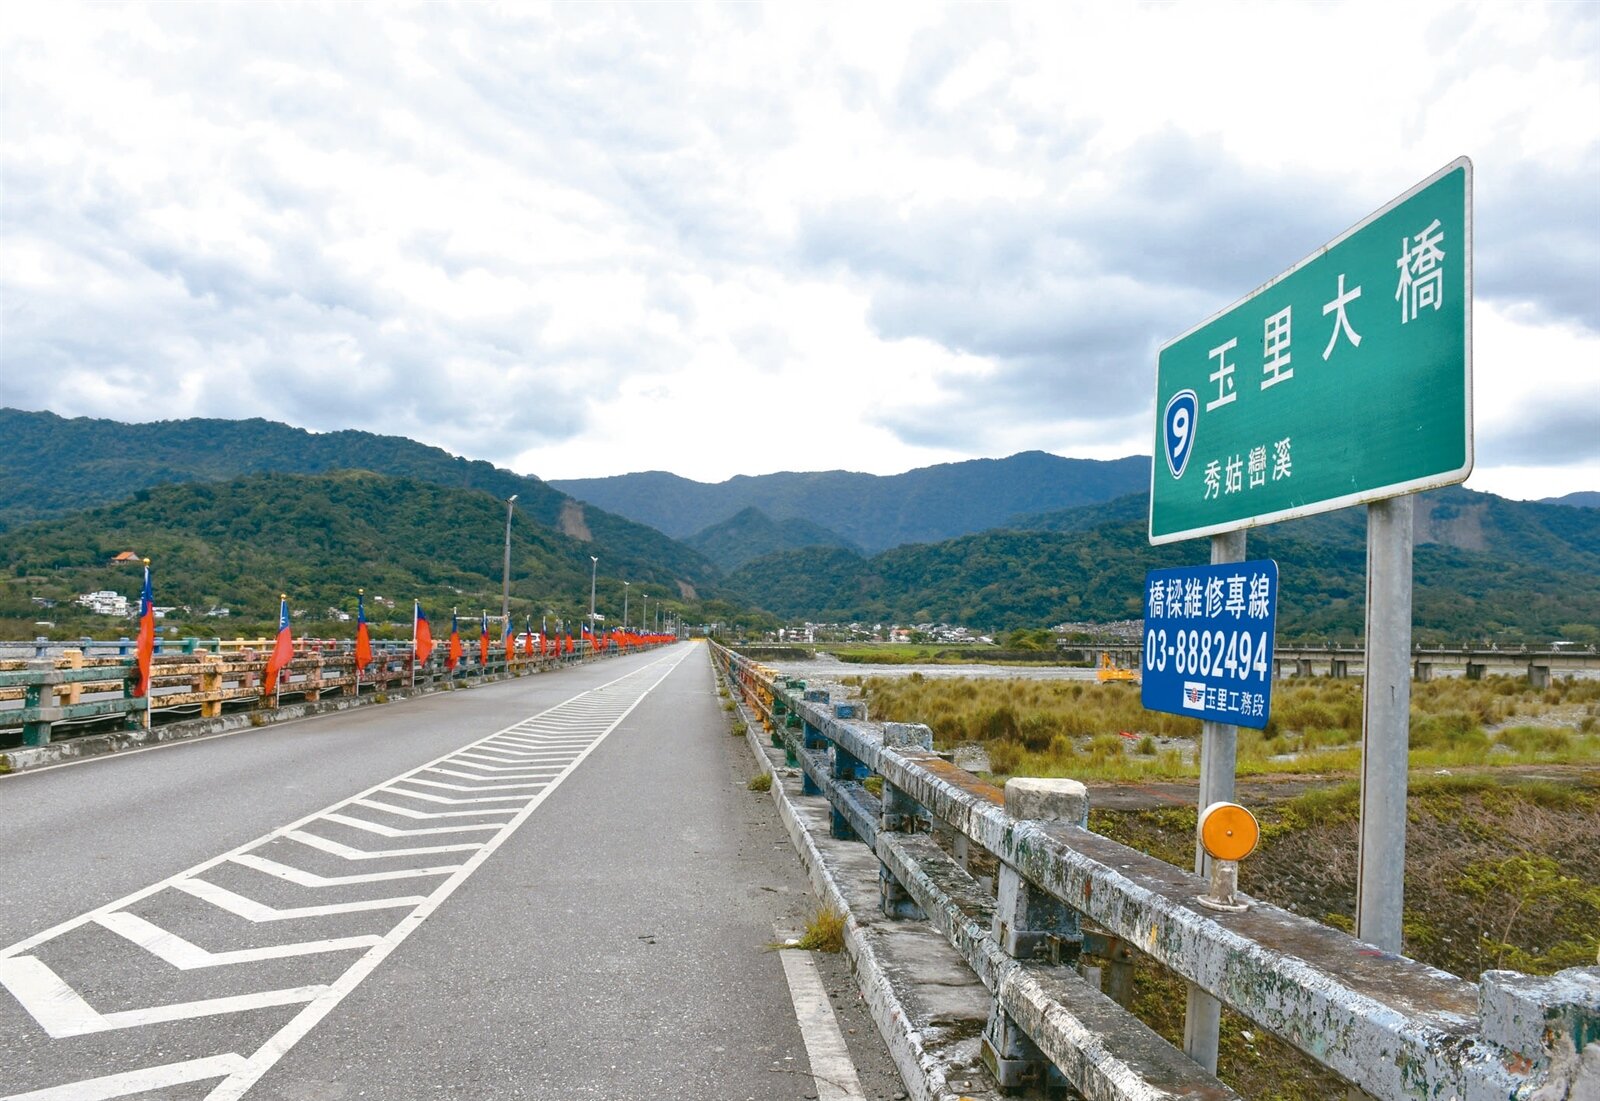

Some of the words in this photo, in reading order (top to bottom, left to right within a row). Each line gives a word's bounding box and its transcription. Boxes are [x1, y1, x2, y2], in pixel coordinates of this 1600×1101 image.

[1206, 218, 1446, 413] 玉里大橋
[1172, 407, 1188, 458] 9
[1204, 437, 1292, 501] 秀姑巒溪
[1148, 572, 1270, 620] 橋樑維修專線
[1146, 628, 1268, 682] 03-8882494
[1205, 687, 1265, 717] 玉里工務段
